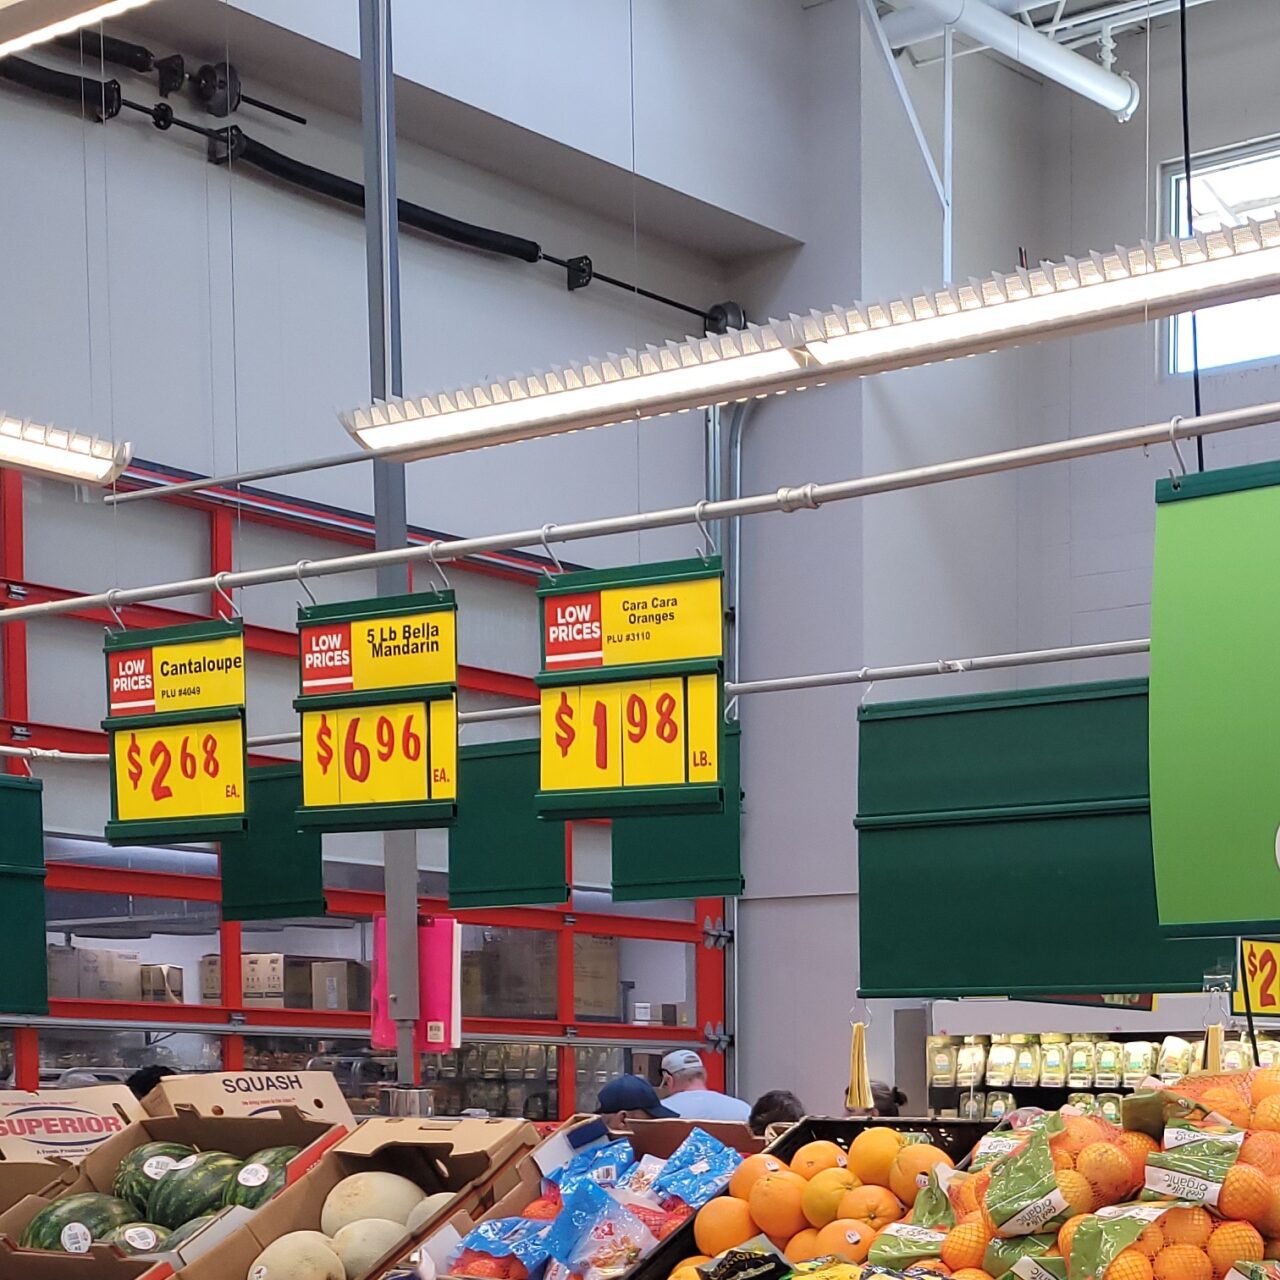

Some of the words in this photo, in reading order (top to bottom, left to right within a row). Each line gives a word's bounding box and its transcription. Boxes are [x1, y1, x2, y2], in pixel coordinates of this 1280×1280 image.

[622, 600, 648, 612] Cara
[651, 597, 678, 609] Cara
[557, 604, 592, 624] LOW
[628, 611, 675, 626] Oranges
[367, 629, 375, 644] 5
[380, 626, 397, 642] Lb
[402, 623, 439, 640] Bella
[550, 622, 601, 643] PRICES
[607, 634, 623, 644] PLU
[626, 631, 650, 642] #3110
[312, 634, 342, 651] LOW
[371, 639, 439, 658] Mandarin
[119, 659, 145, 675] LOW
[160, 656, 242, 677] Cantaloupe
[305, 651, 350, 669] PRICES
[113, 675, 152, 692] PRICES
[161, 688, 176, 698] PLU
[178, 686, 201, 697] #4049
[222, 1075, 303, 1093] SQUASH
[0, 1116, 122, 1136] SUPERIOR
[1163, 1173, 1208, 1192] organic
